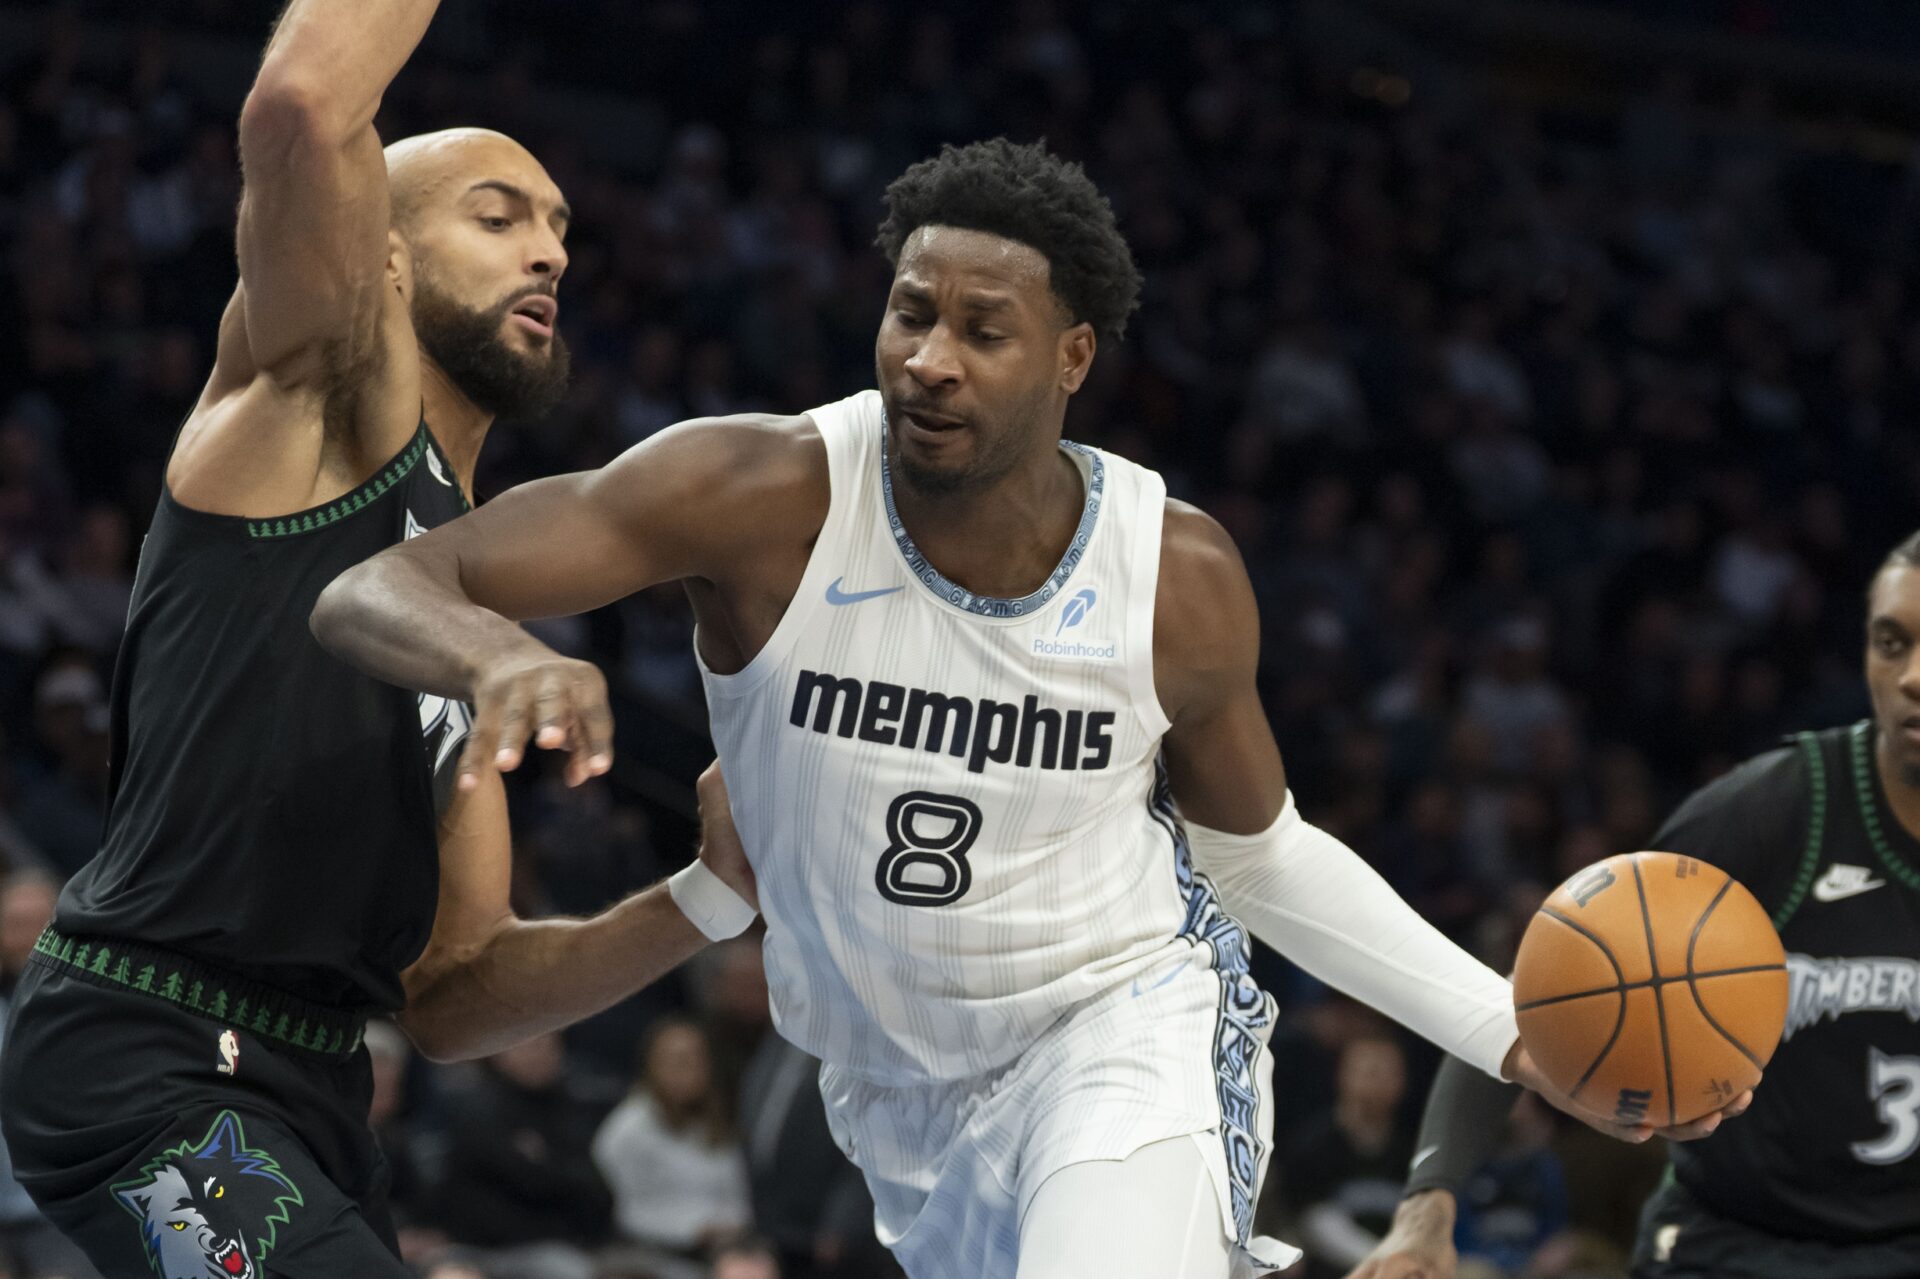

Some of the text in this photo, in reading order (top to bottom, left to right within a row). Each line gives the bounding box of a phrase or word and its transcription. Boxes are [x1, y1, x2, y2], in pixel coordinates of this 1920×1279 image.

[1033, 638, 1116, 659] Robinhood
[789, 669, 1116, 774] memphis
[874, 790, 984, 907] 8
[1783, 952, 1920, 1042] TIMBER
[1850, 1045, 1920, 1166] 3
